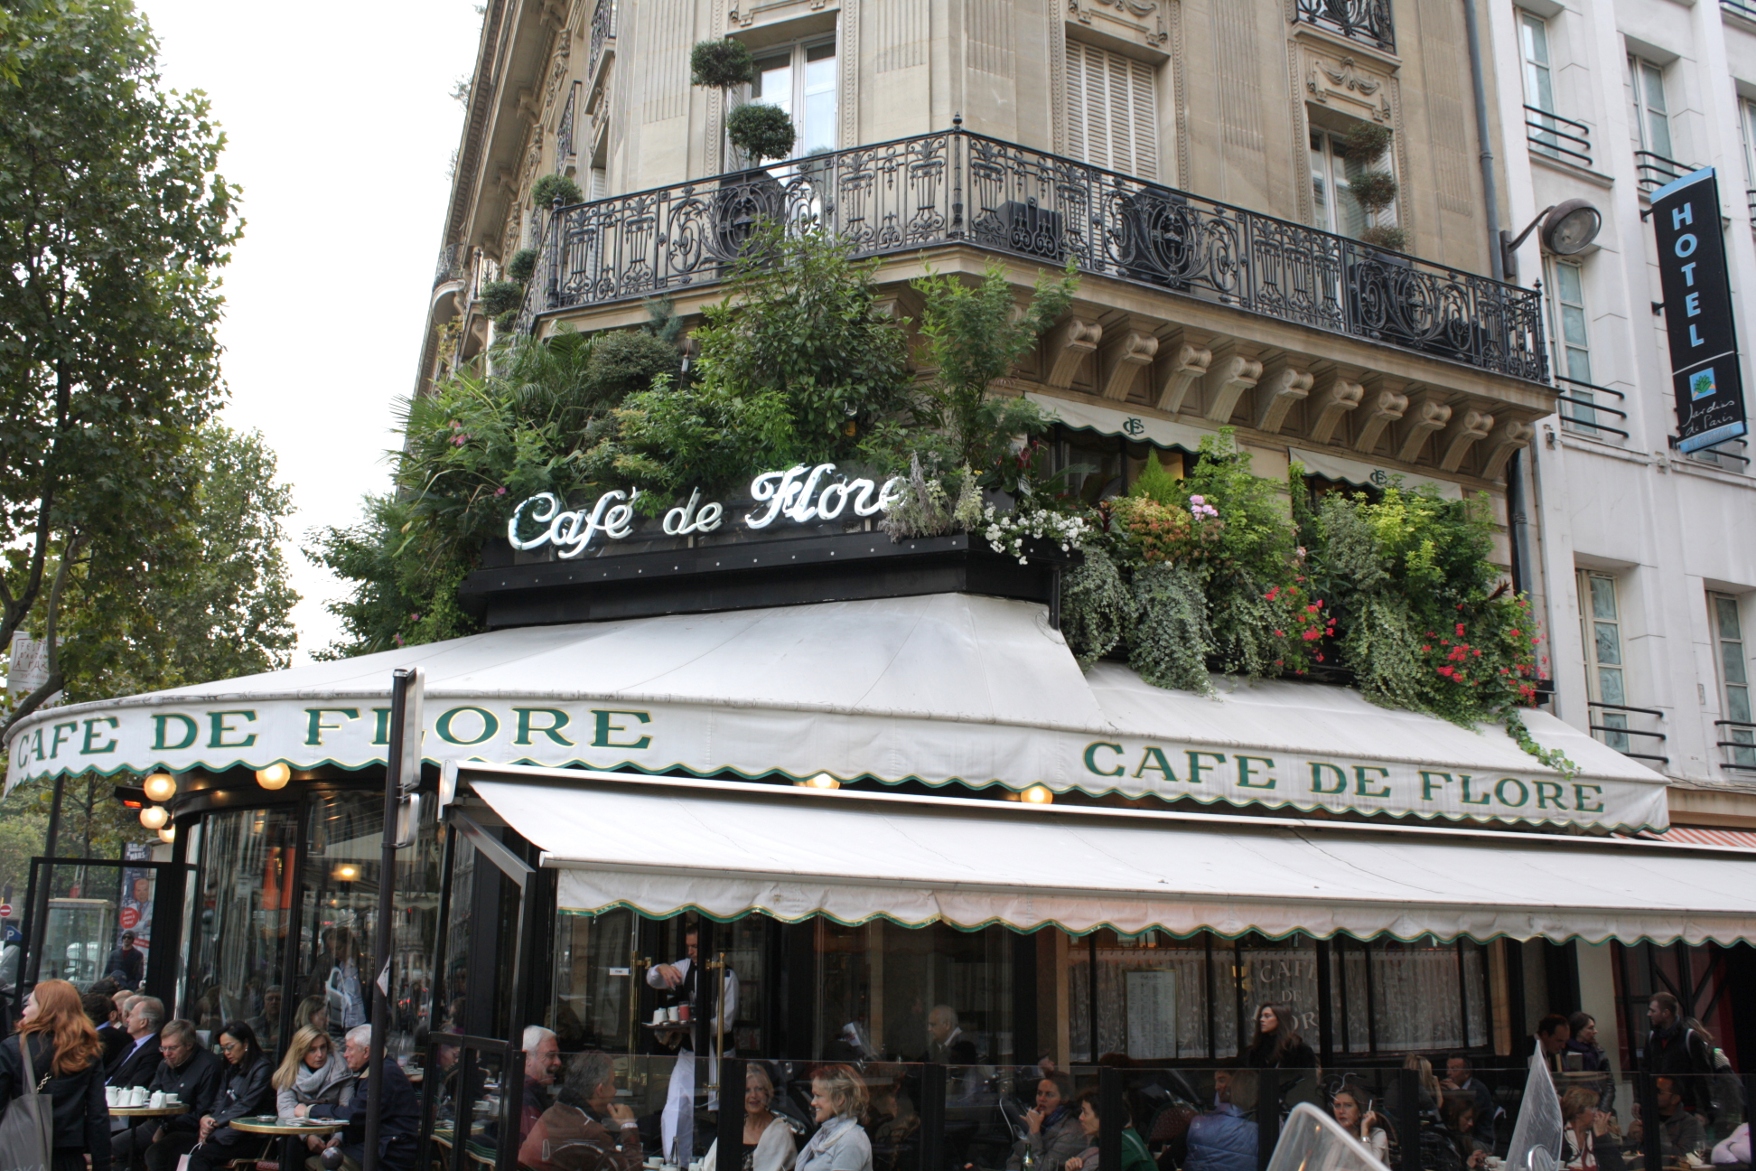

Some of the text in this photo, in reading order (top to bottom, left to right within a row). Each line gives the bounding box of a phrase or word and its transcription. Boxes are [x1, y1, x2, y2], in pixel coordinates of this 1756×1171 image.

[1672, 202, 1705, 347] HOTEL
[1685, 412, 1733, 437] de Paris
[508, 463, 908, 558] Café de Flore
[17, 706, 653, 769] CAFE DE FLORE
[1083, 741, 1604, 813] CAFE DE FLORE
[6, 930, 15, 940] P
[1281, 990, 1302, 1002] DE
